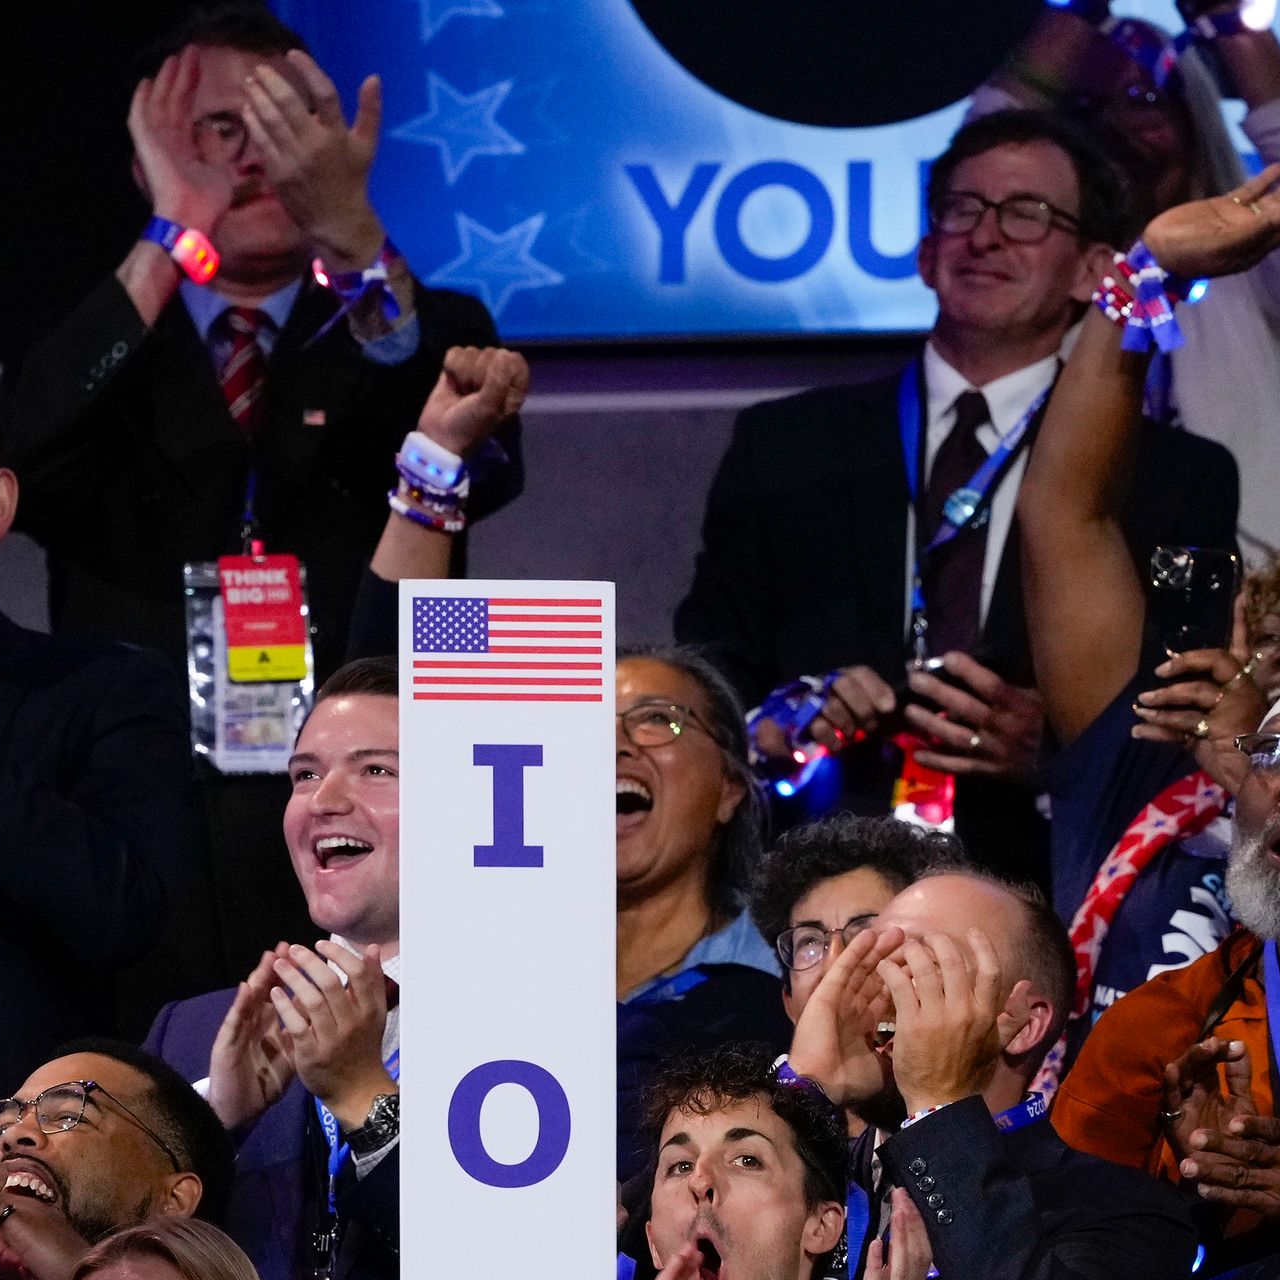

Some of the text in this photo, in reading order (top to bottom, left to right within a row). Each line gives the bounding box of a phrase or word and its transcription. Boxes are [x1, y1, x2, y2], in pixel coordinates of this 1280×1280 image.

[626, 159, 930, 284] YOU
[222, 568, 289, 586] THINK
[226, 588, 264, 604] BIG
